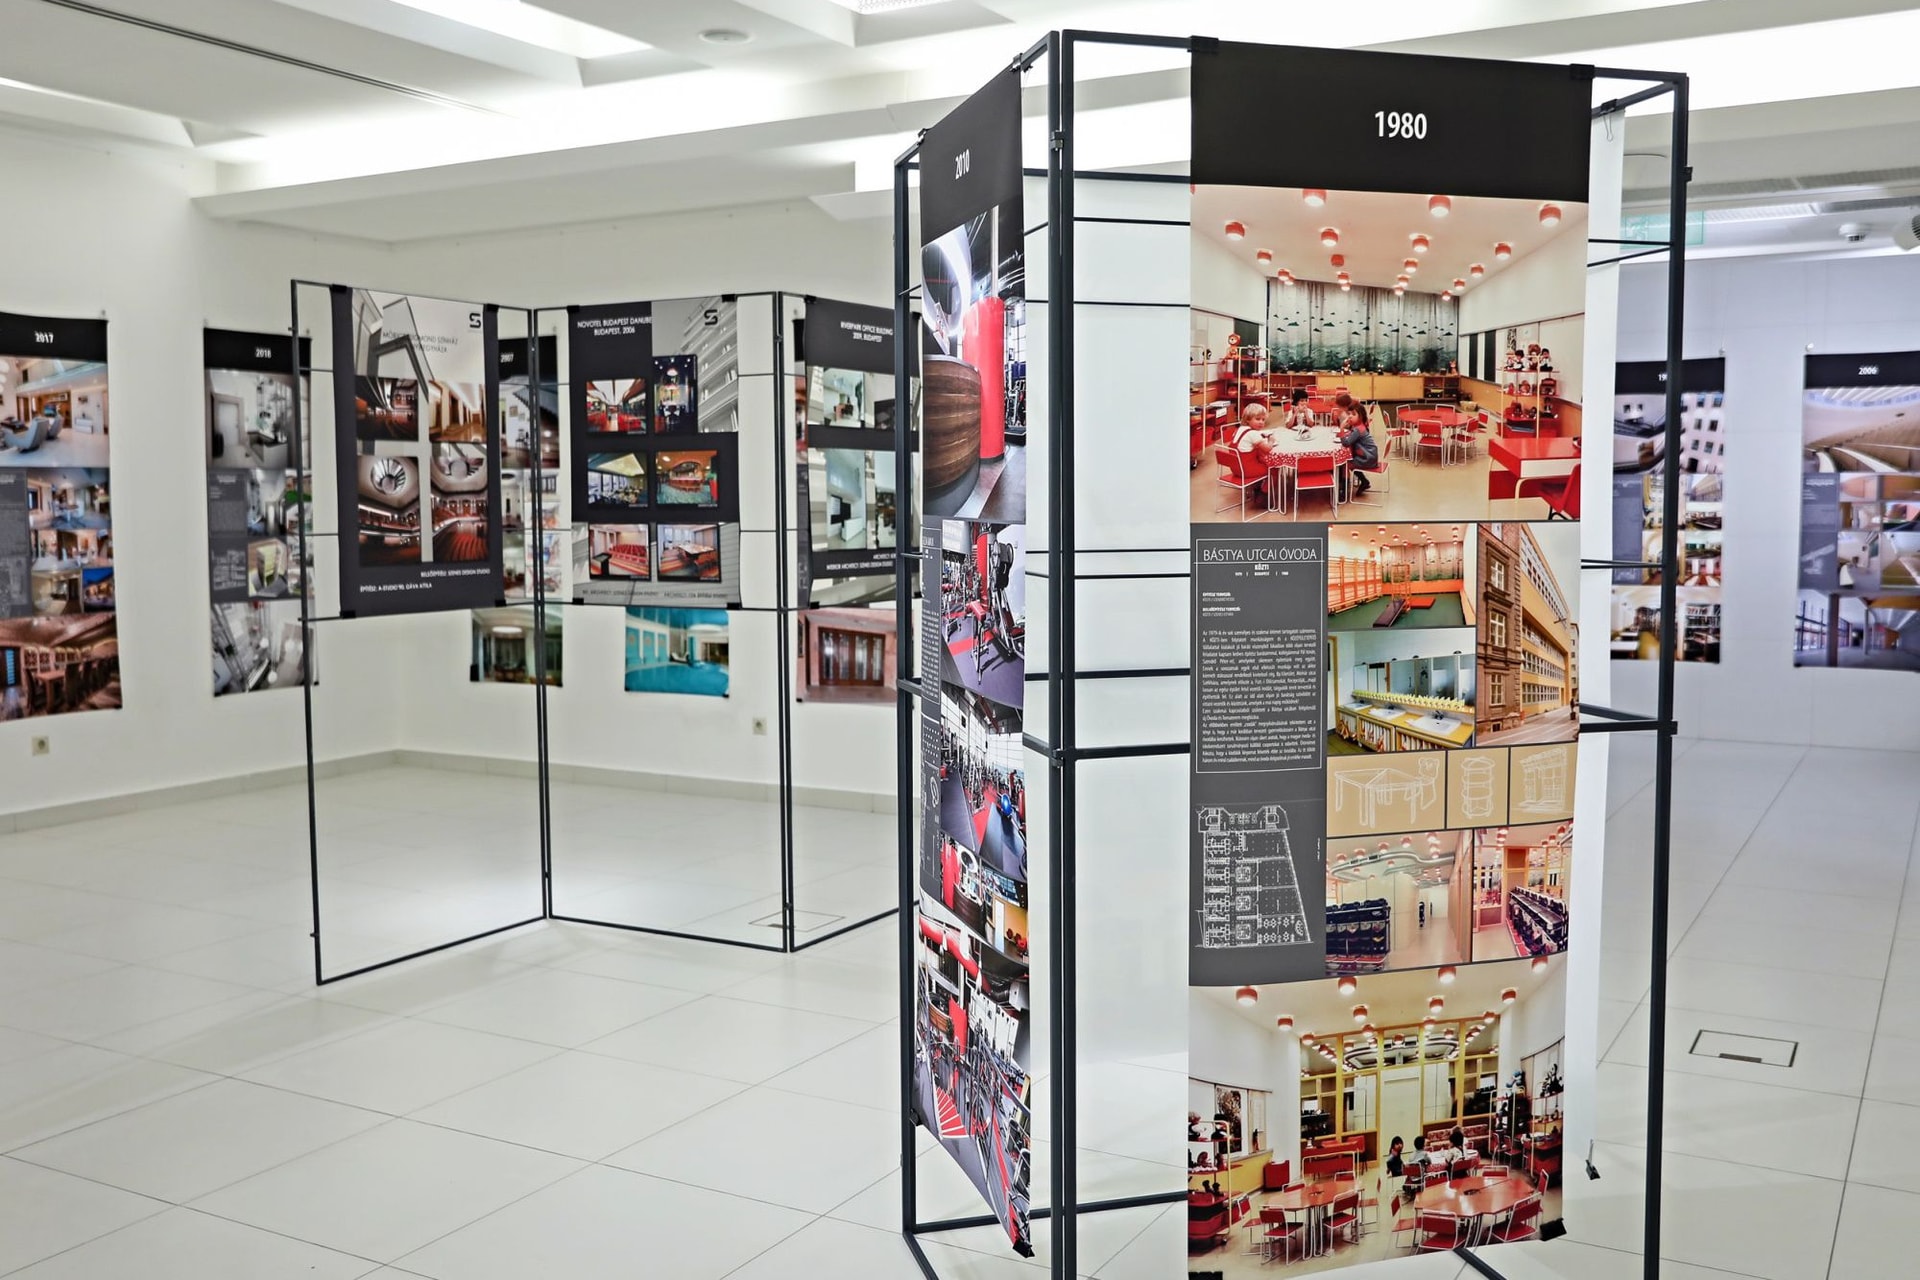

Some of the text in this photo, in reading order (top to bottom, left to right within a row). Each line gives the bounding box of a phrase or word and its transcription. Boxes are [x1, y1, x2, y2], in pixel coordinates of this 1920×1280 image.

[1374, 111, 1427, 140] 1980
[955, 149, 970, 180] 2010
[577, 320, 602, 328] NOVOTEL
[602, 318, 629, 327] BUDAPEST
[622, 326, 635, 335] 2006
[34, 331, 54, 344] 2017
[1858, 366, 1878, 375] 2006
[1203, 547, 1317, 561] BÁSTYA UTCAI ÓVODA
